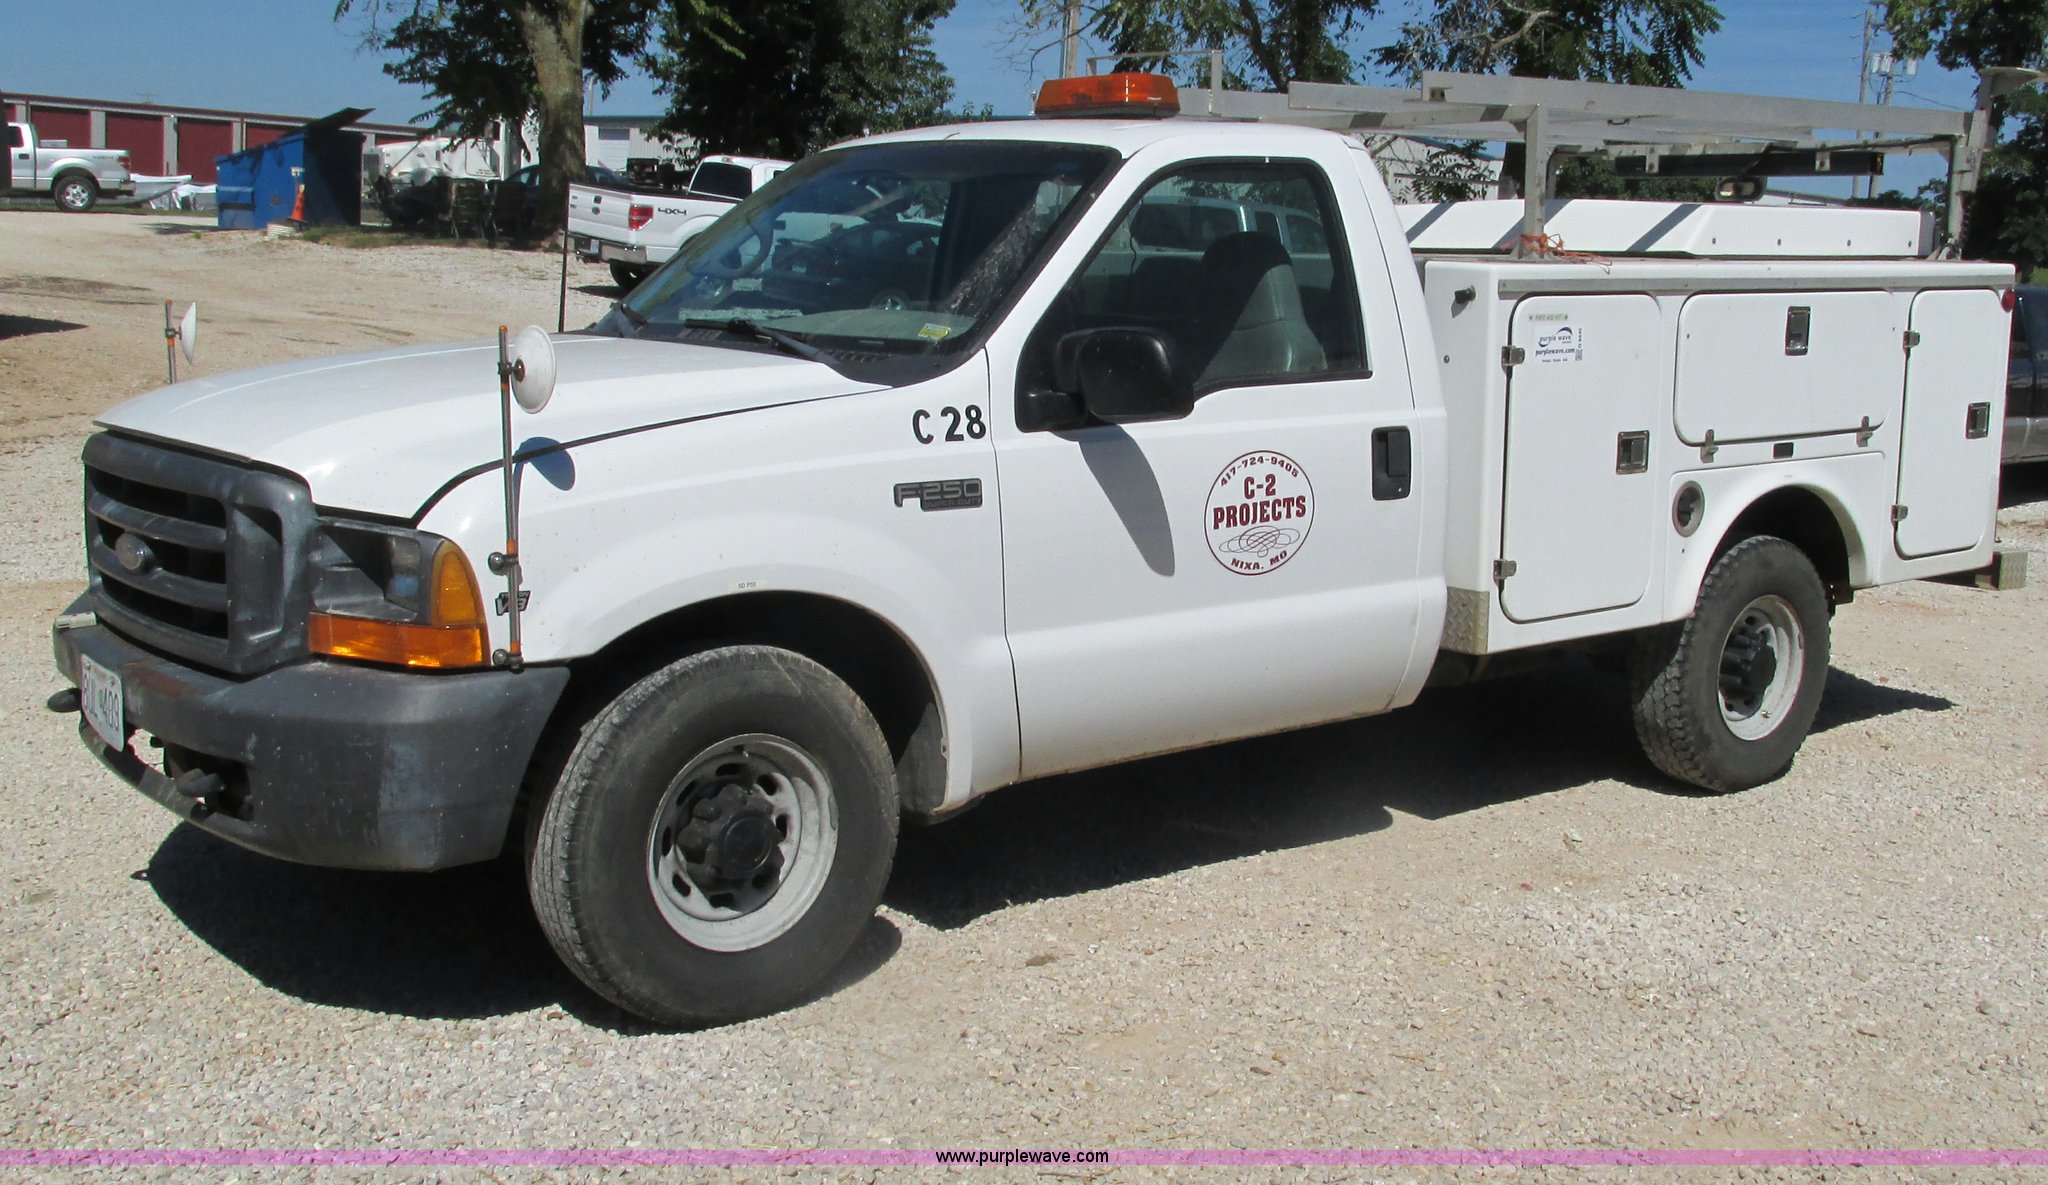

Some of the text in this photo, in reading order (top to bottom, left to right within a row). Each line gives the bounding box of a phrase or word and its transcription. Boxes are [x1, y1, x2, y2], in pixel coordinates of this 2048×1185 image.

[1535, 348, 1575, 356] purplewave.com
[912, 404, 987, 445] C 28
[1220, 455, 1299, 487] 417-724-9405
[1243, 473, 1276, 499] C-2
[1212, 495, 1307, 530] PROJECTS
[1269, 549, 1288, 566] MO
